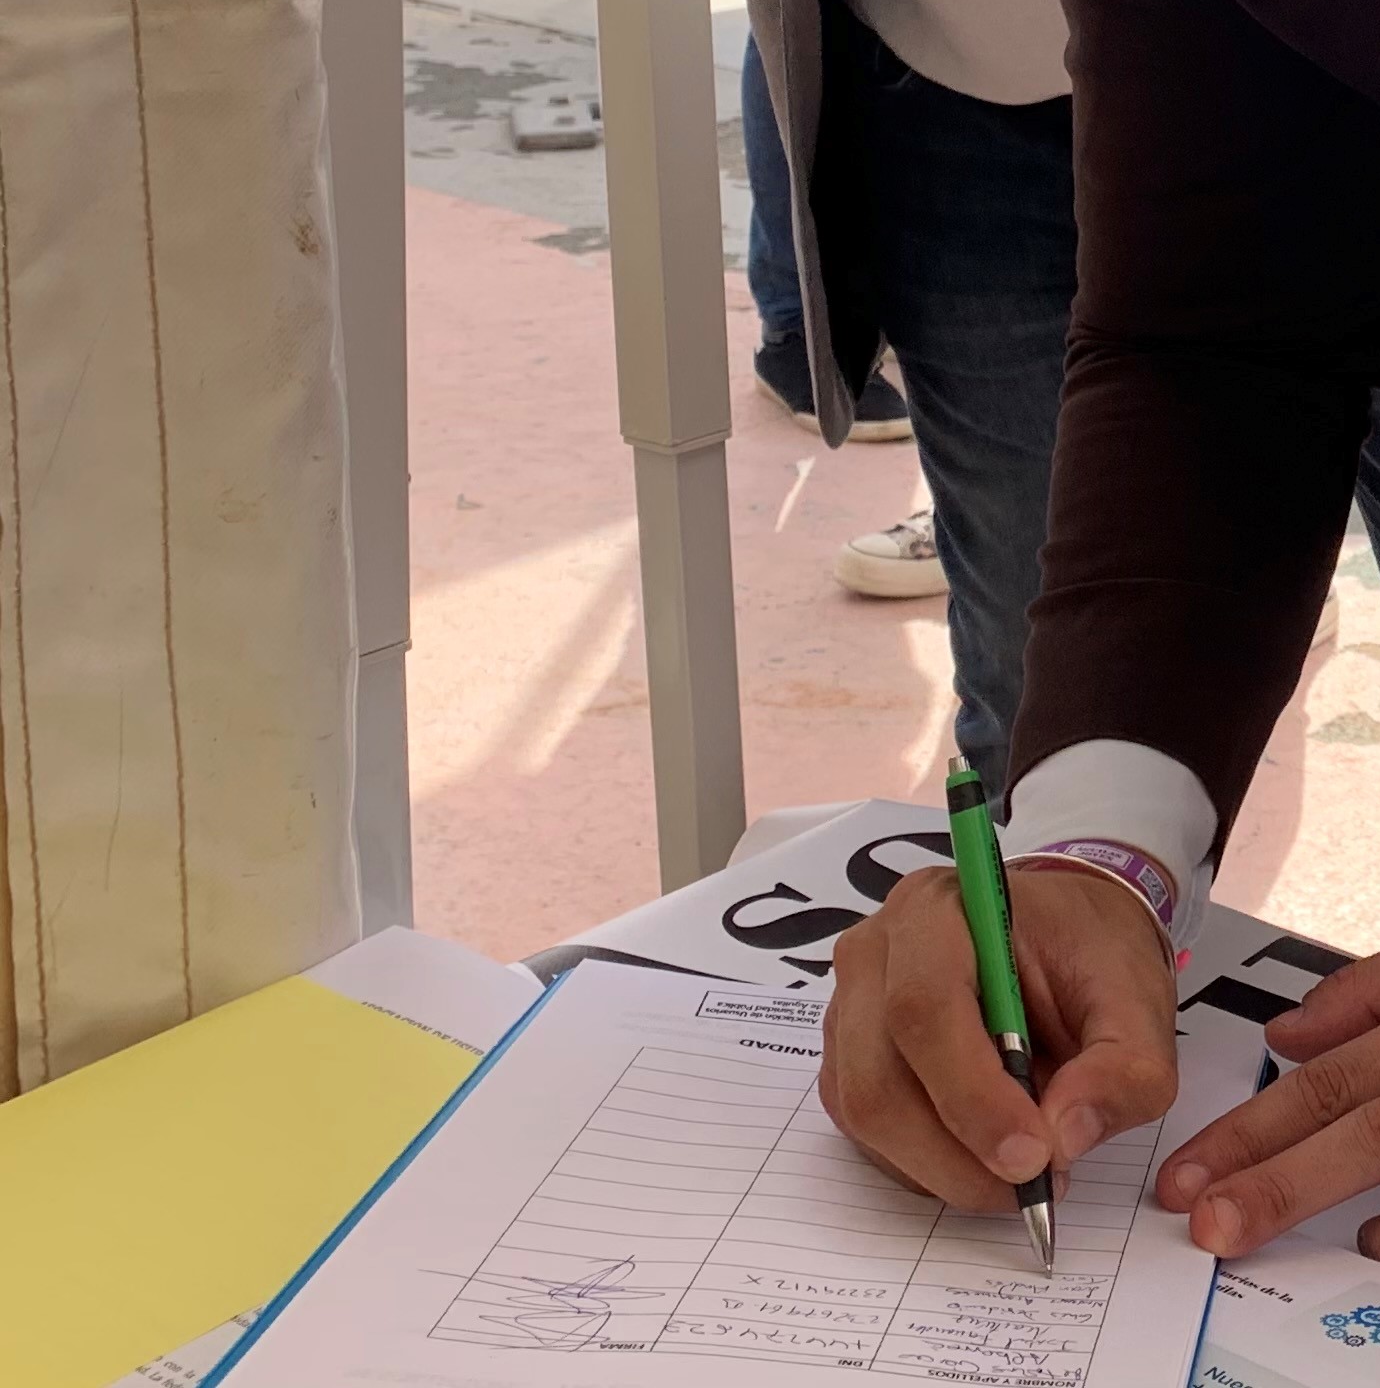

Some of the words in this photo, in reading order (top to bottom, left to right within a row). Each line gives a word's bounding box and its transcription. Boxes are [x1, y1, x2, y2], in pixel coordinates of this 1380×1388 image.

[739, 1038, 823, 1058] ANIDAD
[599, 1342, 645, 1352] FIRMA
[838, 1359, 864, 1368] DNI
[927, 1369, 1000, 1384] APELLIDOS
[1203, 1366, 1253, 1388] Nue
[1015, 1378, 1076, 1388] NOMBRE
